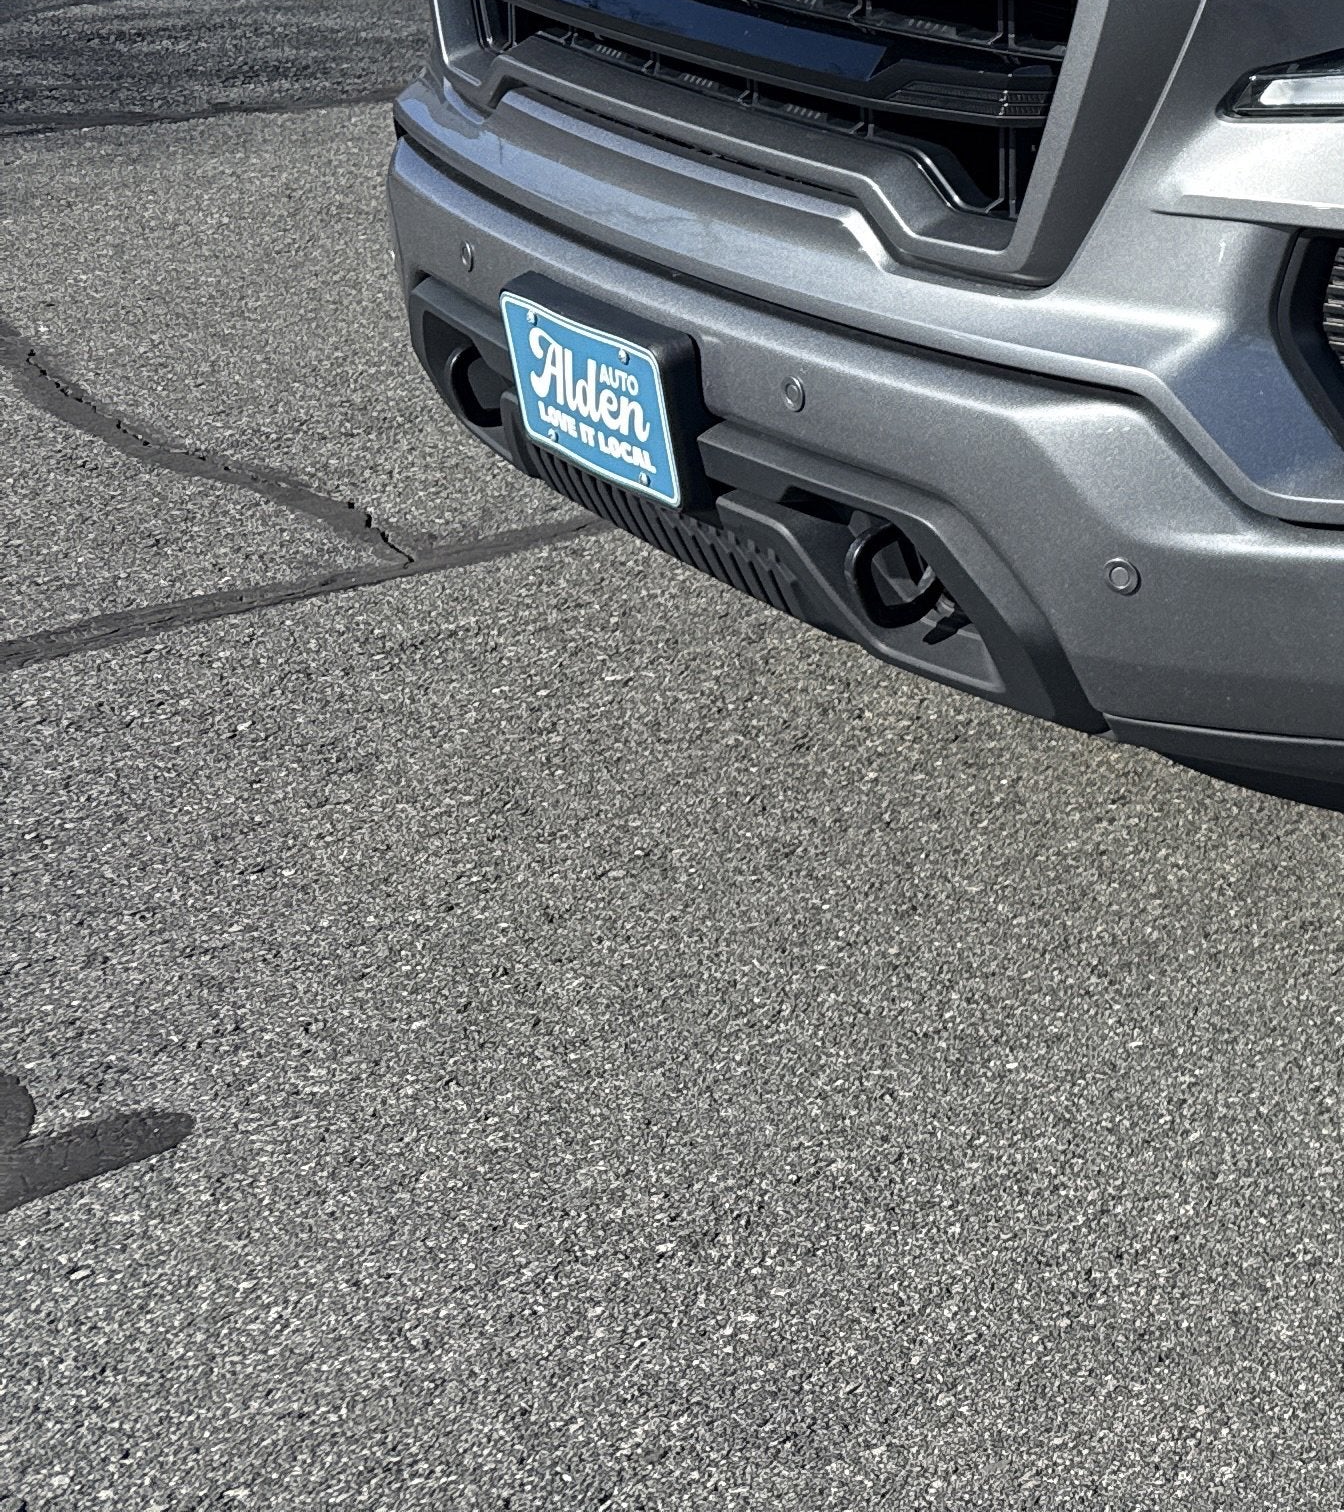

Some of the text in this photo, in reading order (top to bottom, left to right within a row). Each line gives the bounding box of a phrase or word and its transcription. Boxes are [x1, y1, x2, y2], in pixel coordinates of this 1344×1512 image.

[529, 326, 651, 443] Alden
[600, 363, 639, 396] AUTO
[538, 400, 657, 474] LOVE IT LOCAL
